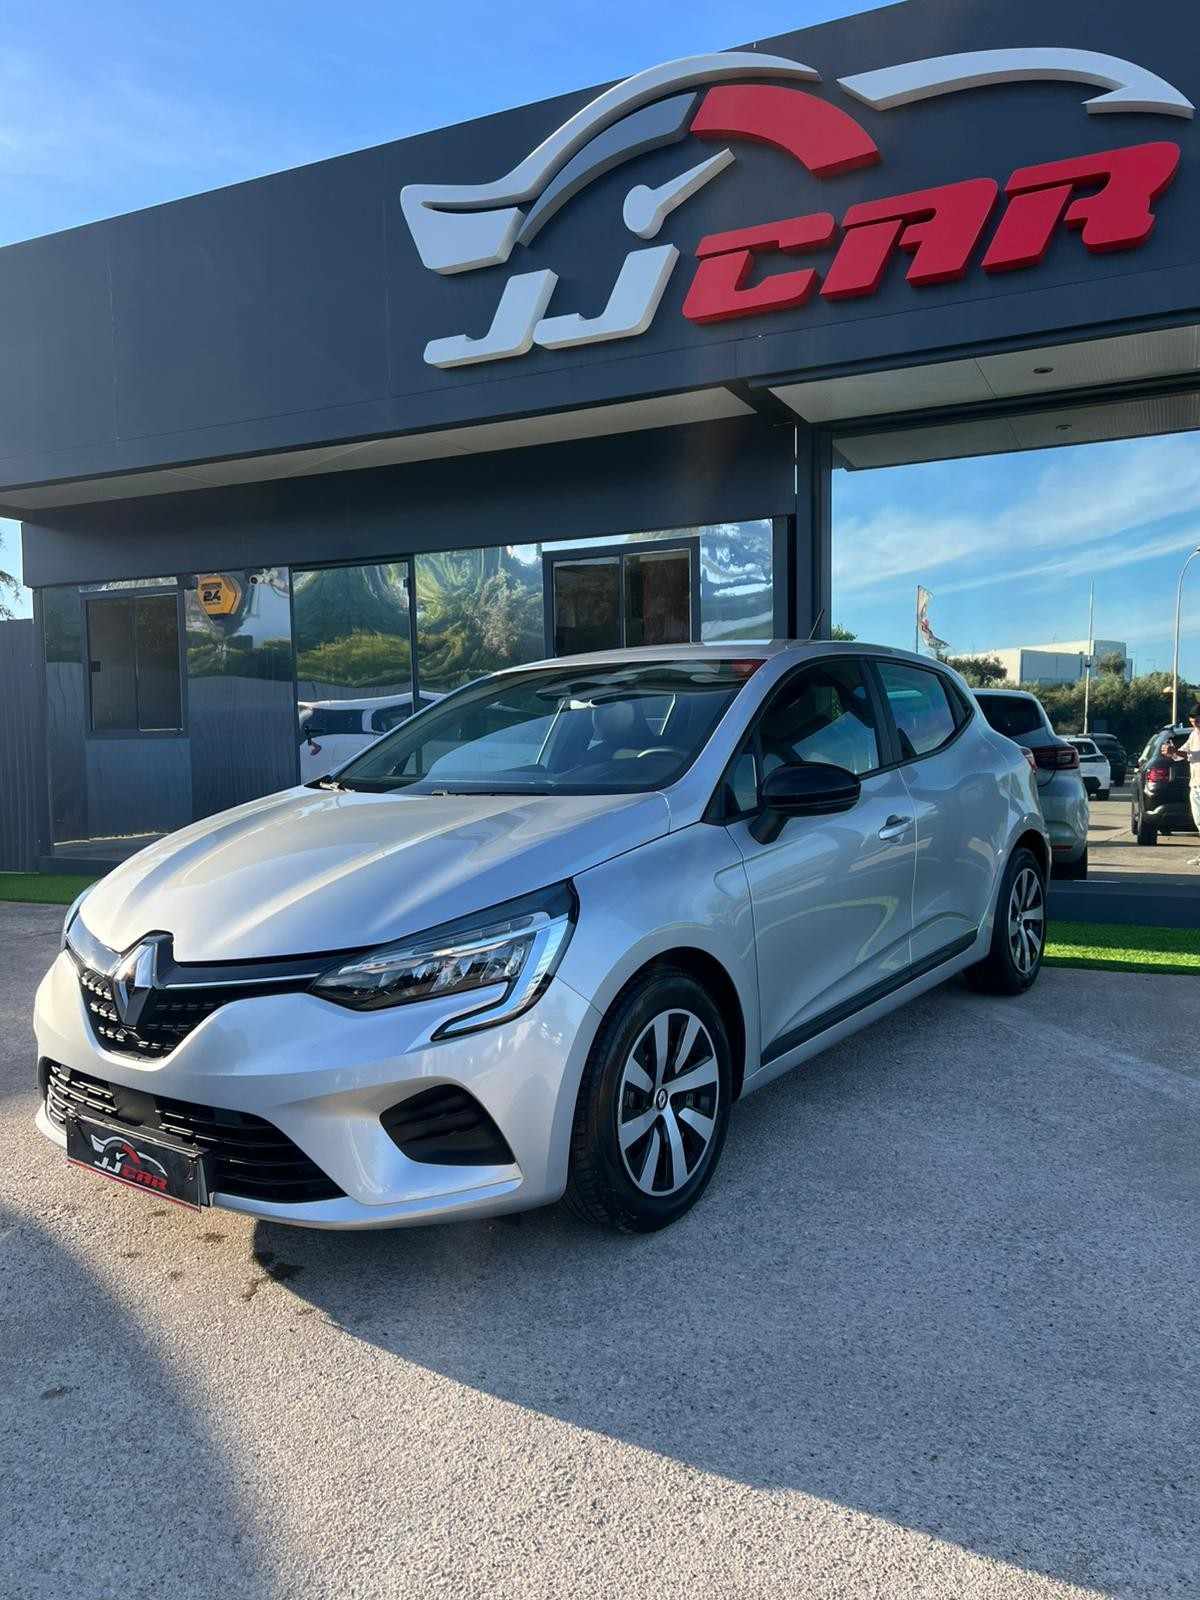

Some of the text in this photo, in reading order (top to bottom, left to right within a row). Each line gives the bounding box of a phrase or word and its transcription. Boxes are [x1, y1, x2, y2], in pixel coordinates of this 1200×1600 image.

[423, 141, 1180, 369] JJ CAR
[121, 1164, 168, 1190] CAR
